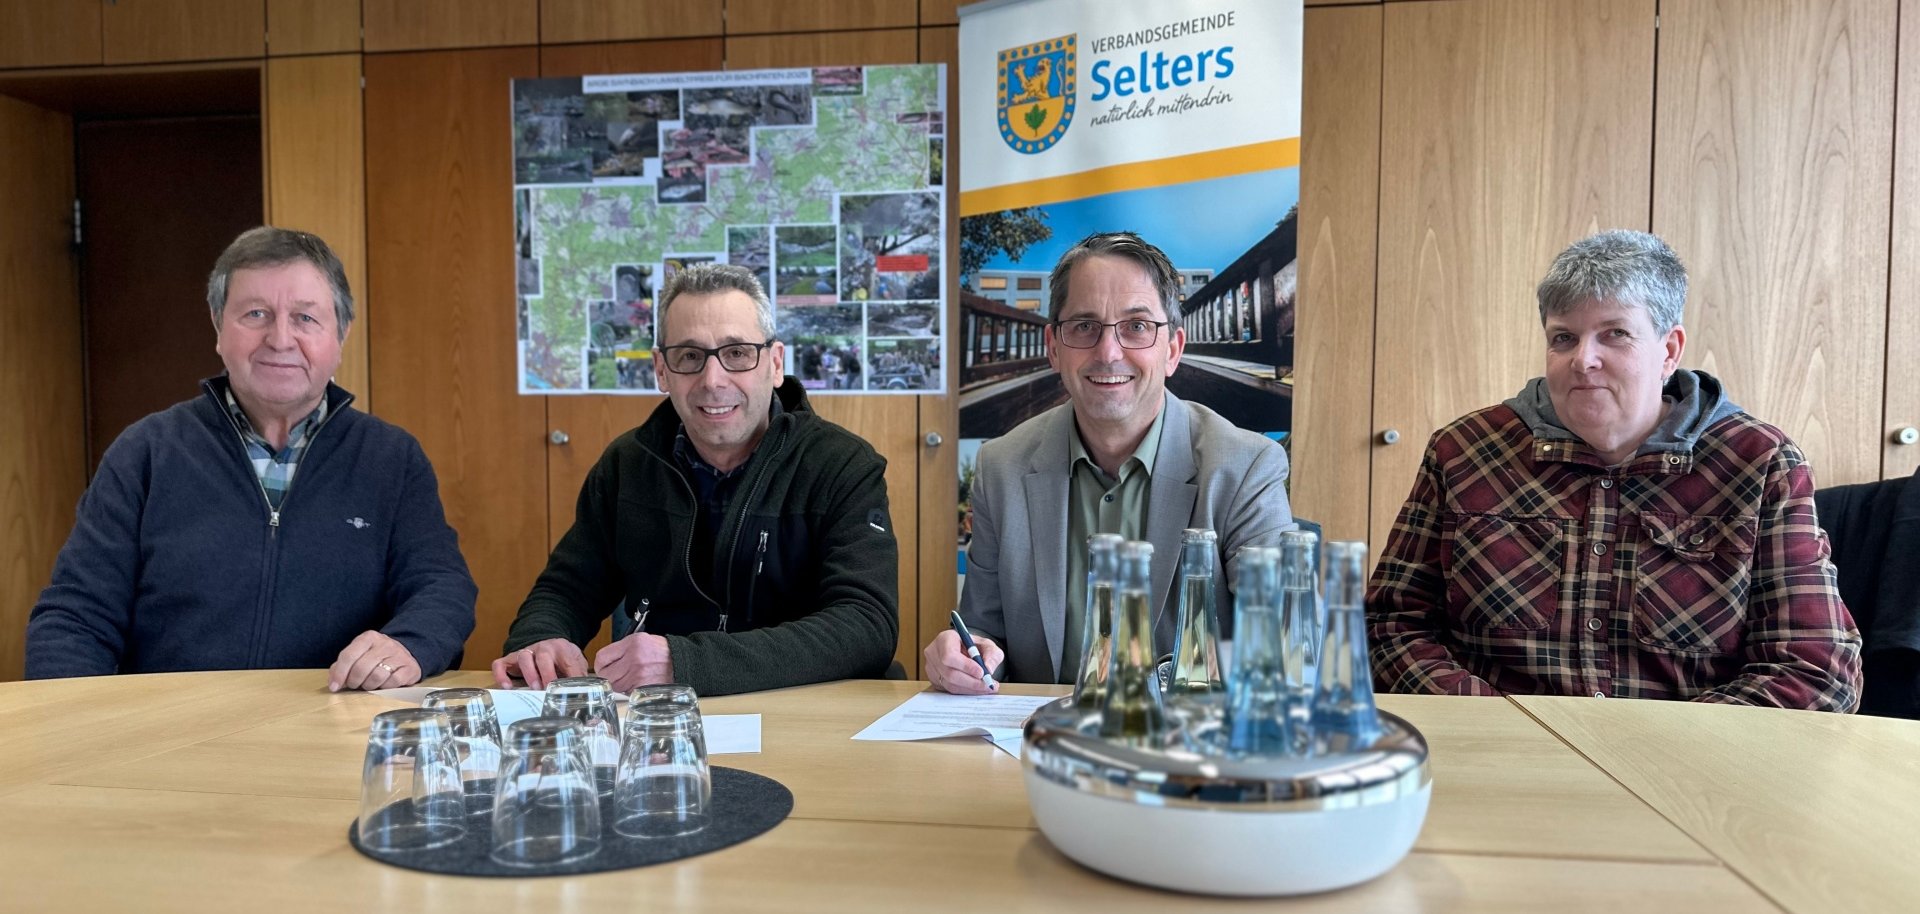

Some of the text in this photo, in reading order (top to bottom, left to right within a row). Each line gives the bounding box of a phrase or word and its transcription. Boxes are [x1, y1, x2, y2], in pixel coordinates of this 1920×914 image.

[1091, 11, 1236, 54] VERBANDSGEMEINDE
[1090, 46, 1235, 101] Selters
[1090, 85, 1233, 127] natürlich mittendrin
